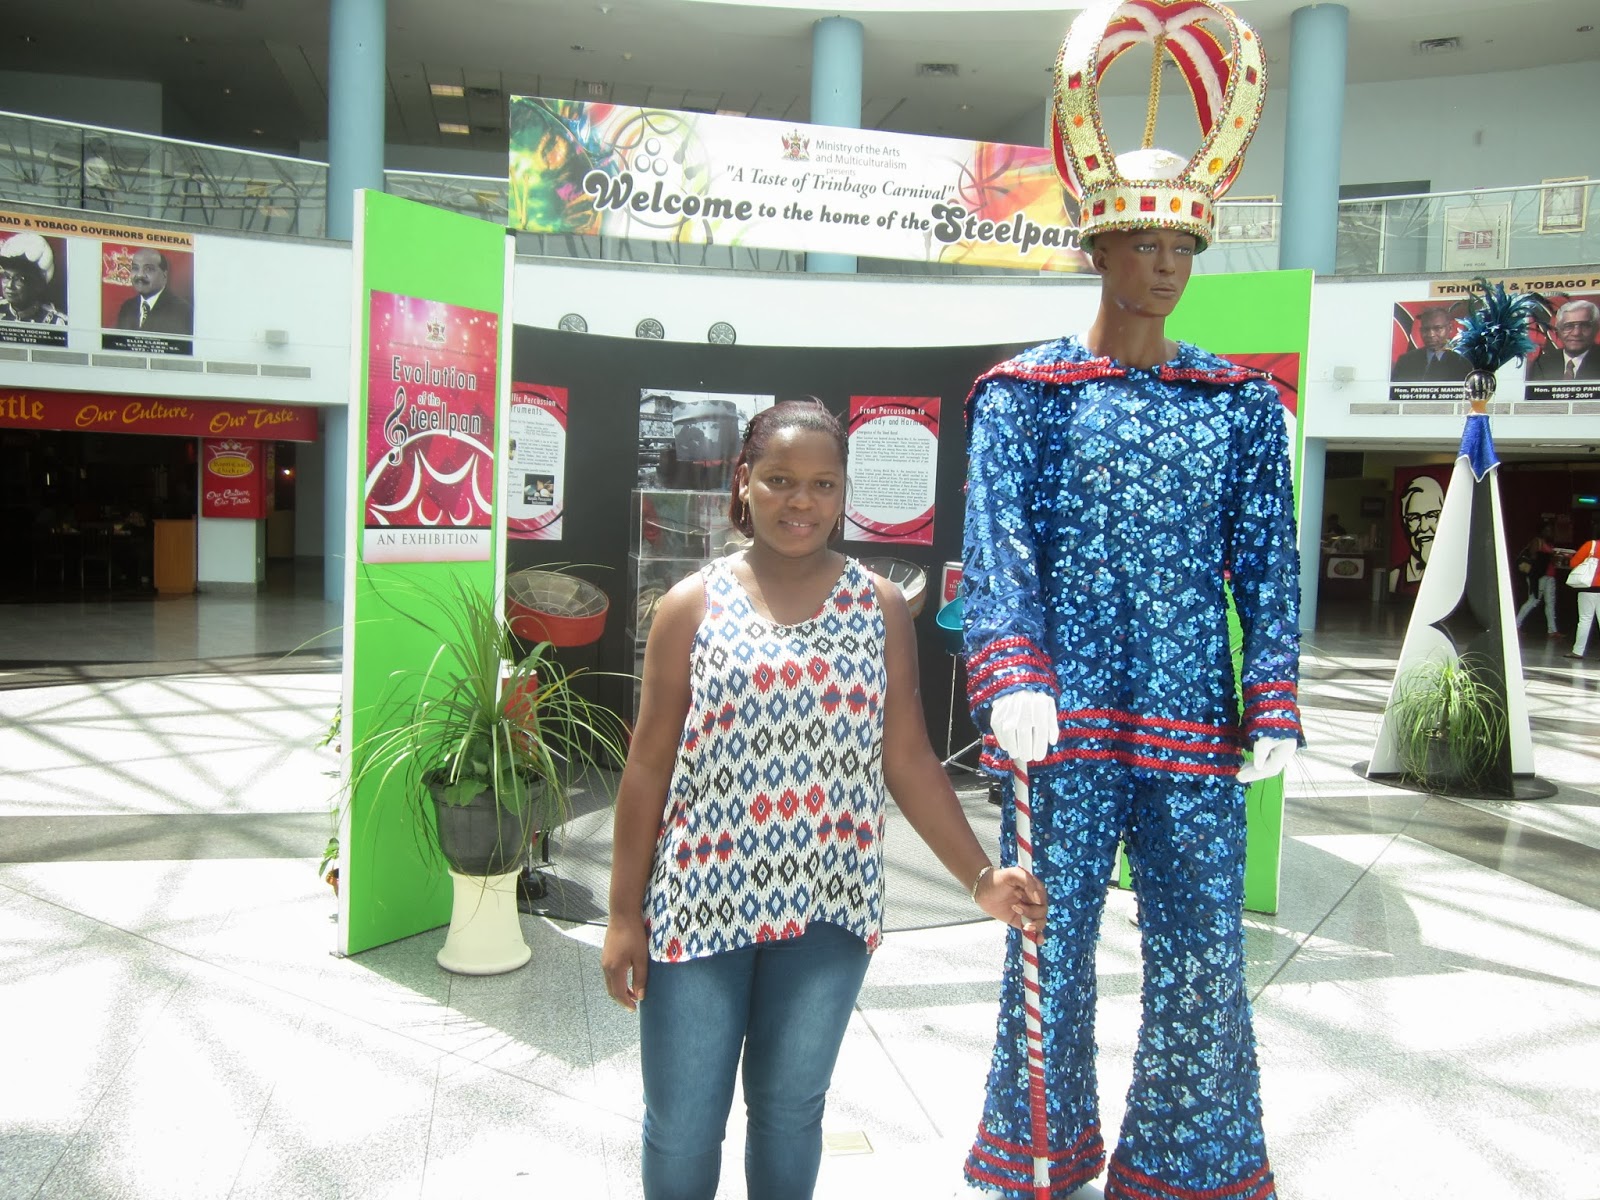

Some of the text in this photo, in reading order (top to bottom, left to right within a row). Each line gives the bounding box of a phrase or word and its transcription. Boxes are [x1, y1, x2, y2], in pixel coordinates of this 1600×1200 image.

[815, 140, 900, 157] Ministry of the Arts
[815, 153, 907, 170] and Multiculturalism
[826, 168, 856, 177] presents
[726, 165, 955, 200] "A Taste of Trinbago Carnival"
[584, 172, 1081, 253] Welcome to the home of the Steelpan
[24, 218, 32, 227] &
[34, 219, 78, 232] TOBAGO
[80, 226, 144, 240] GOVERNORS
[146, 233, 192, 246] GENERAL
[1509, 282, 1520, 291] &
[1524, 279, 1586, 290] TOBAGO
[392, 355, 477, 390] Evolution
[417, 391, 441, 406] of the
[523, 395, 556, 407] Percussion
[75, 404, 117, 427] Our
[122, 401, 195, 424] Culture,
[209, 411, 247, 433] Our
[247, 408, 300, 429] Taste.
[859, 405, 877, 415] From
[879, 406, 916, 415] Percussion
[888, 418, 899, 426] and
[206, 491, 222, 499] Our
[214, 498, 229, 507] Our
[377, 533, 479, 546] AN EXHIBITION
